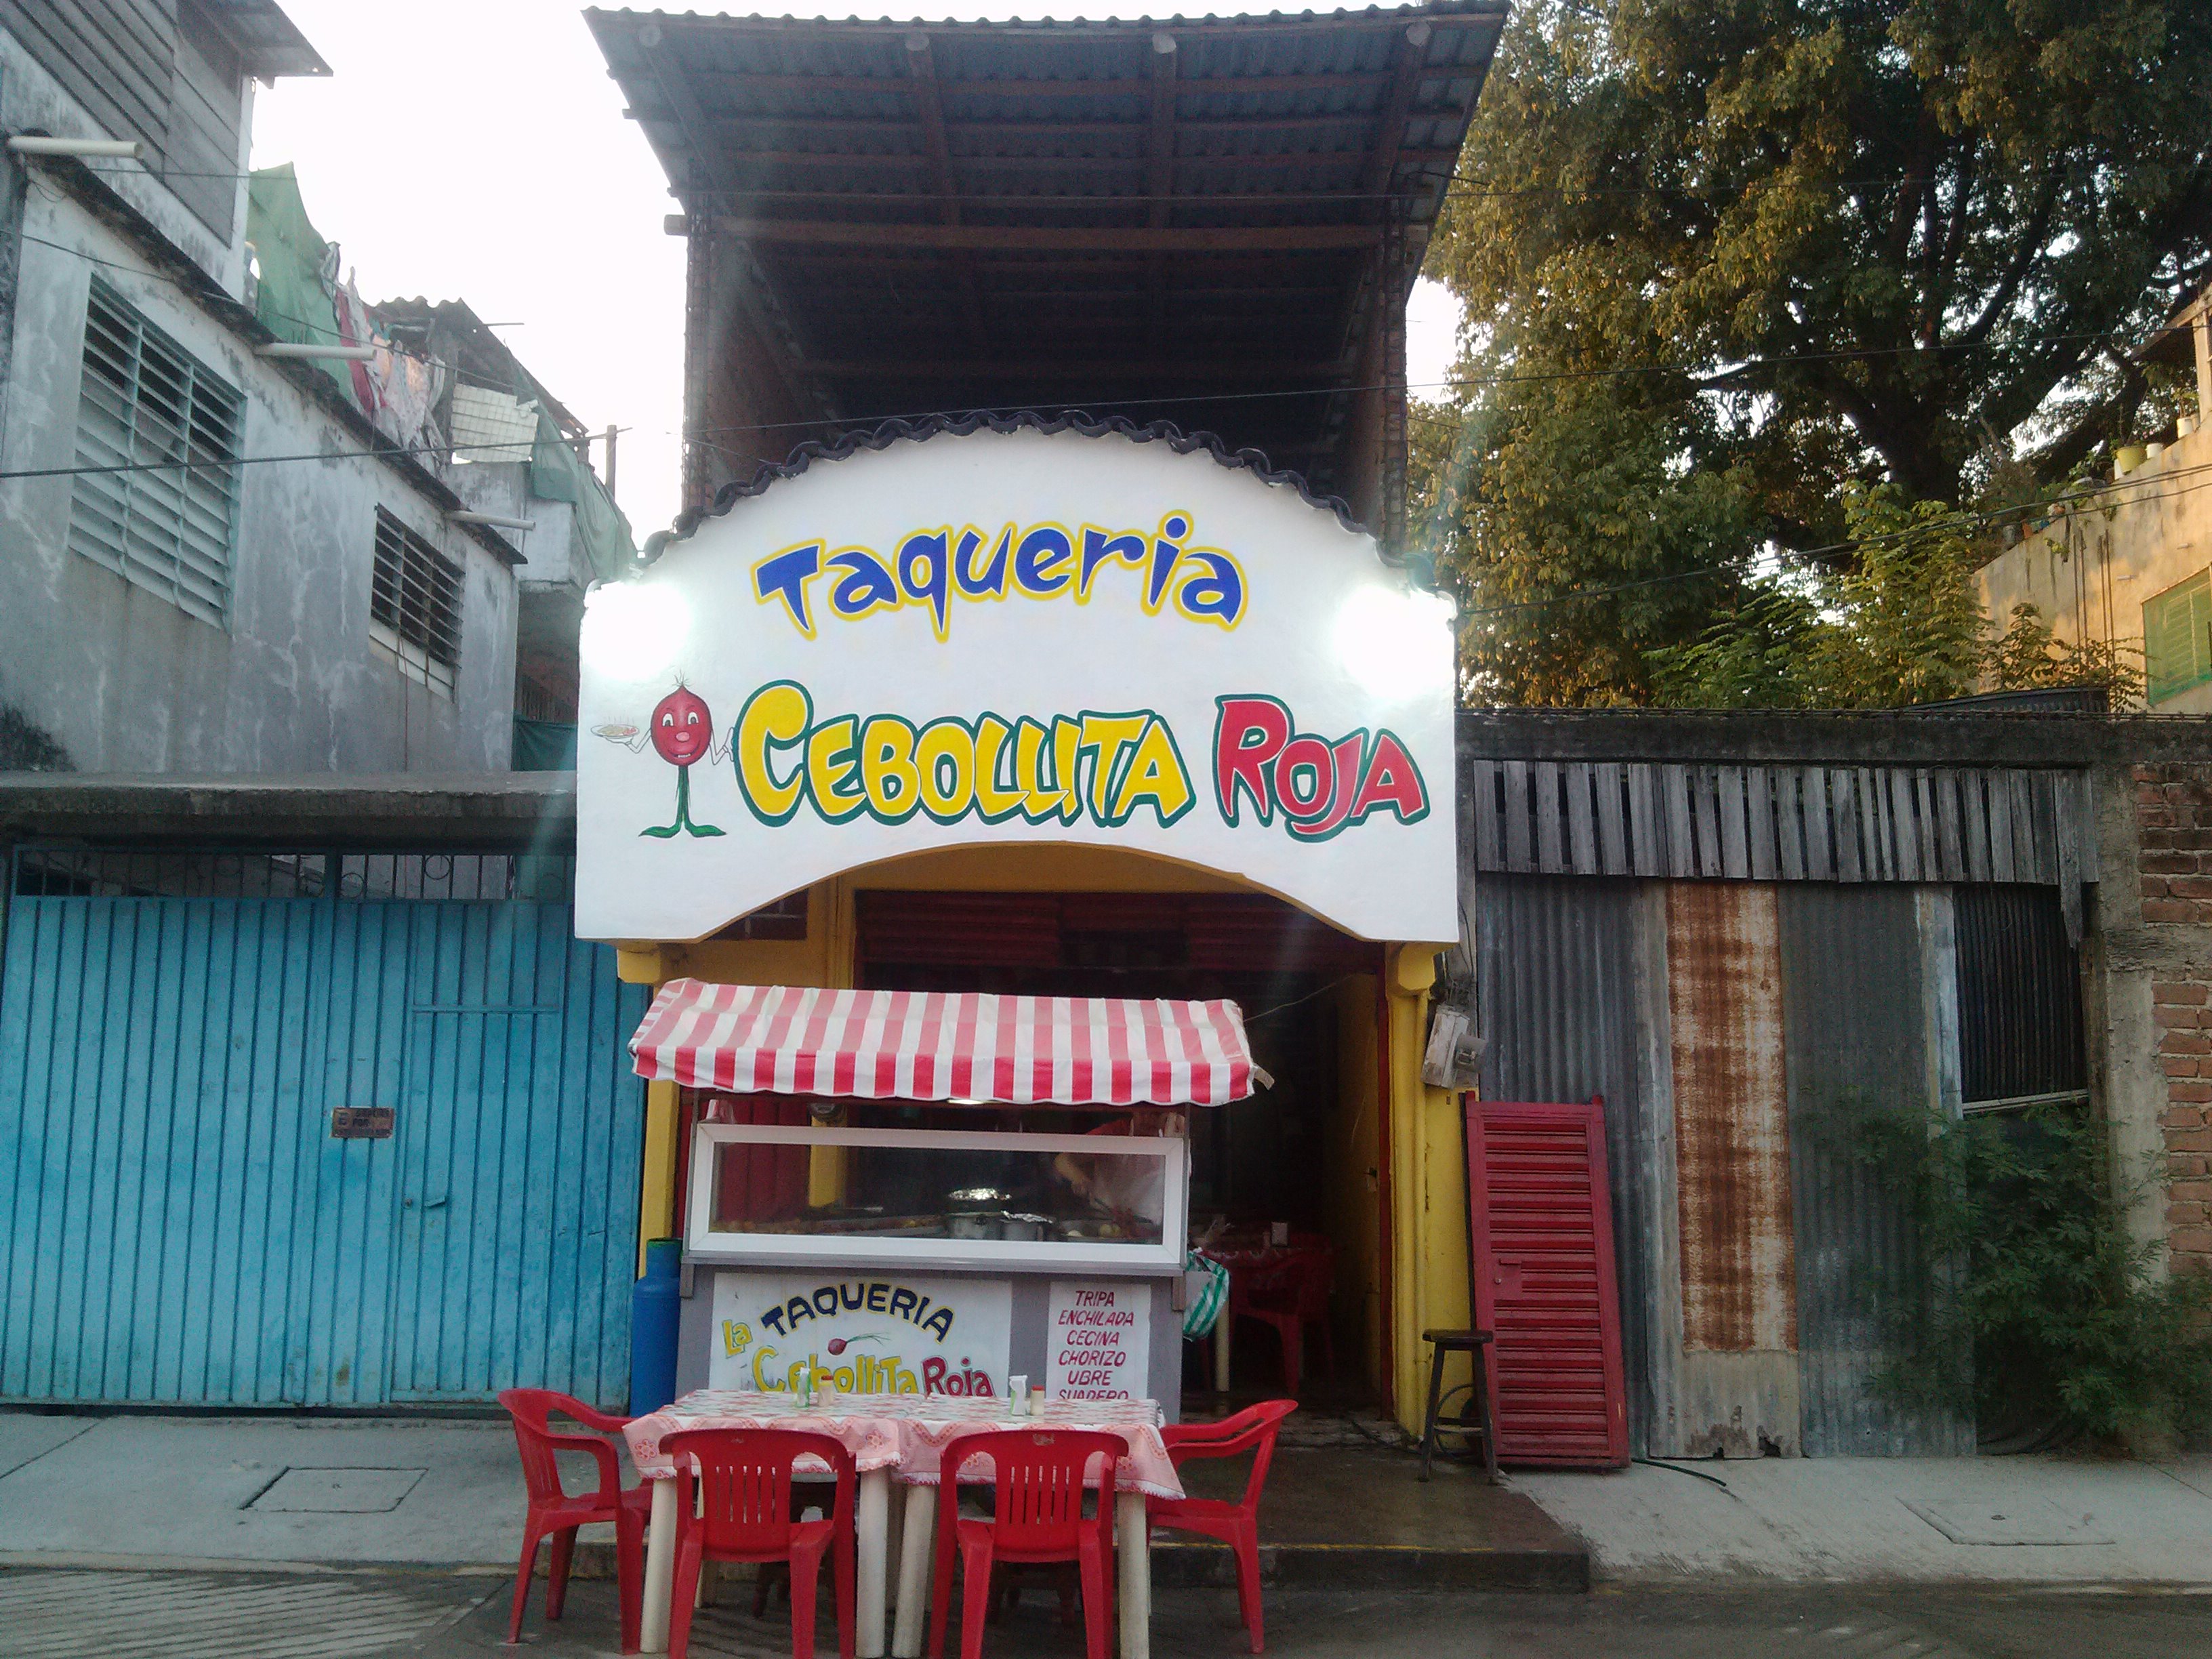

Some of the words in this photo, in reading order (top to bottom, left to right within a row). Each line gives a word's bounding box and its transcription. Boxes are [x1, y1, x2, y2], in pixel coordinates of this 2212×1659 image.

[750, 510, 1248, 642] Taqueria
[734, 679, 1197, 828] CEBOLLITA
[1213, 693, 1431, 843] ROJA
[1075, 1290, 1115, 1307] TRIPA
[758, 1282, 956, 1345] TAQUERIA
[1058, 1309, 1135, 1327] ENCHILADA
[722, 1319, 754, 1359] La
[1066, 1329, 1120, 1347] CECINA
[1058, 1349, 1127, 1368] CHORIZO
[1067, 1370, 1114, 1386] UBRE
